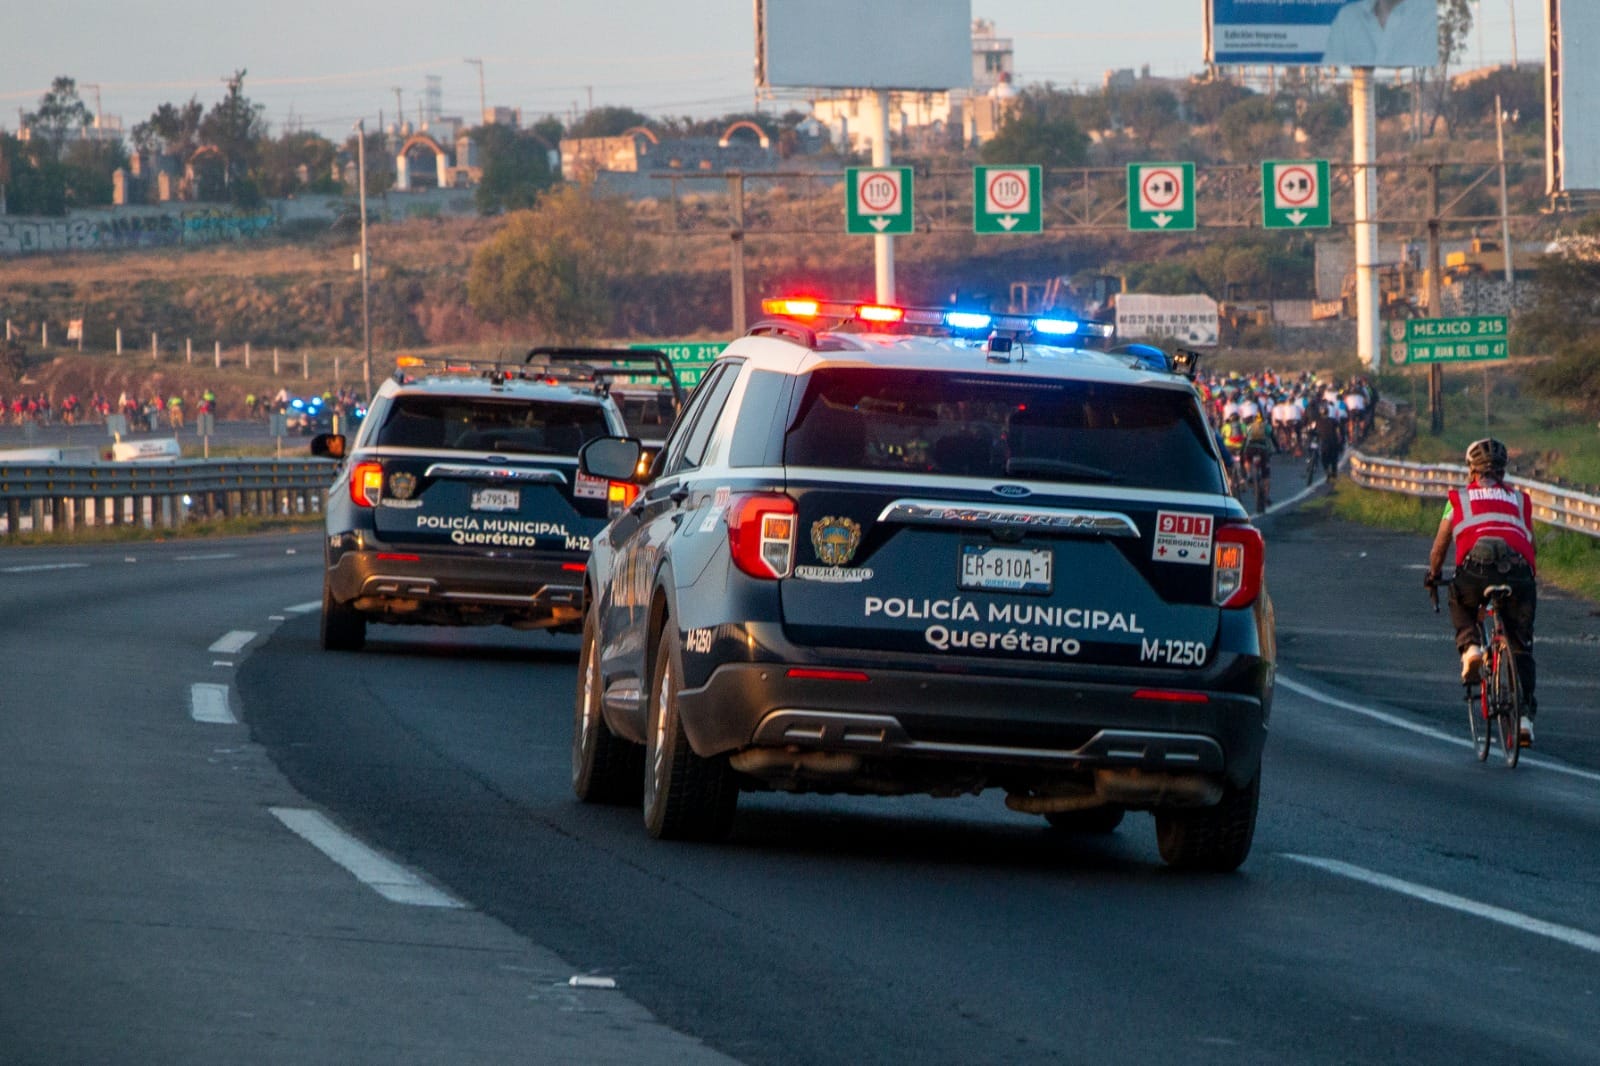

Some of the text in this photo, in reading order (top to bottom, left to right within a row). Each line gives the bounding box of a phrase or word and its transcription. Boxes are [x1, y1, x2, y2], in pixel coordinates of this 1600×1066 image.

[868, 182, 891, 198] 110
[998, 181, 1020, 197] 110
[1413, 320, 1504, 336] MEXICO 215
[1000, 486, 1023, 496] Ford
[416, 515, 570, 537] POLICÍA MUNICIPAL
[1163, 516, 1206, 534] 911
[451, 530, 536, 547] Querétaro
[1157, 538, 1210, 549] EMERGENCIAS
[965, 555, 1050, 580] ER-810A-1
[863, 595, 1145, 634] POLICÍA MUNICIPAL
[686, 627, 712, 654] M-1250
[924, 624, 1081, 656] Querétaro
[1139, 637, 1207, 667] M-1250
